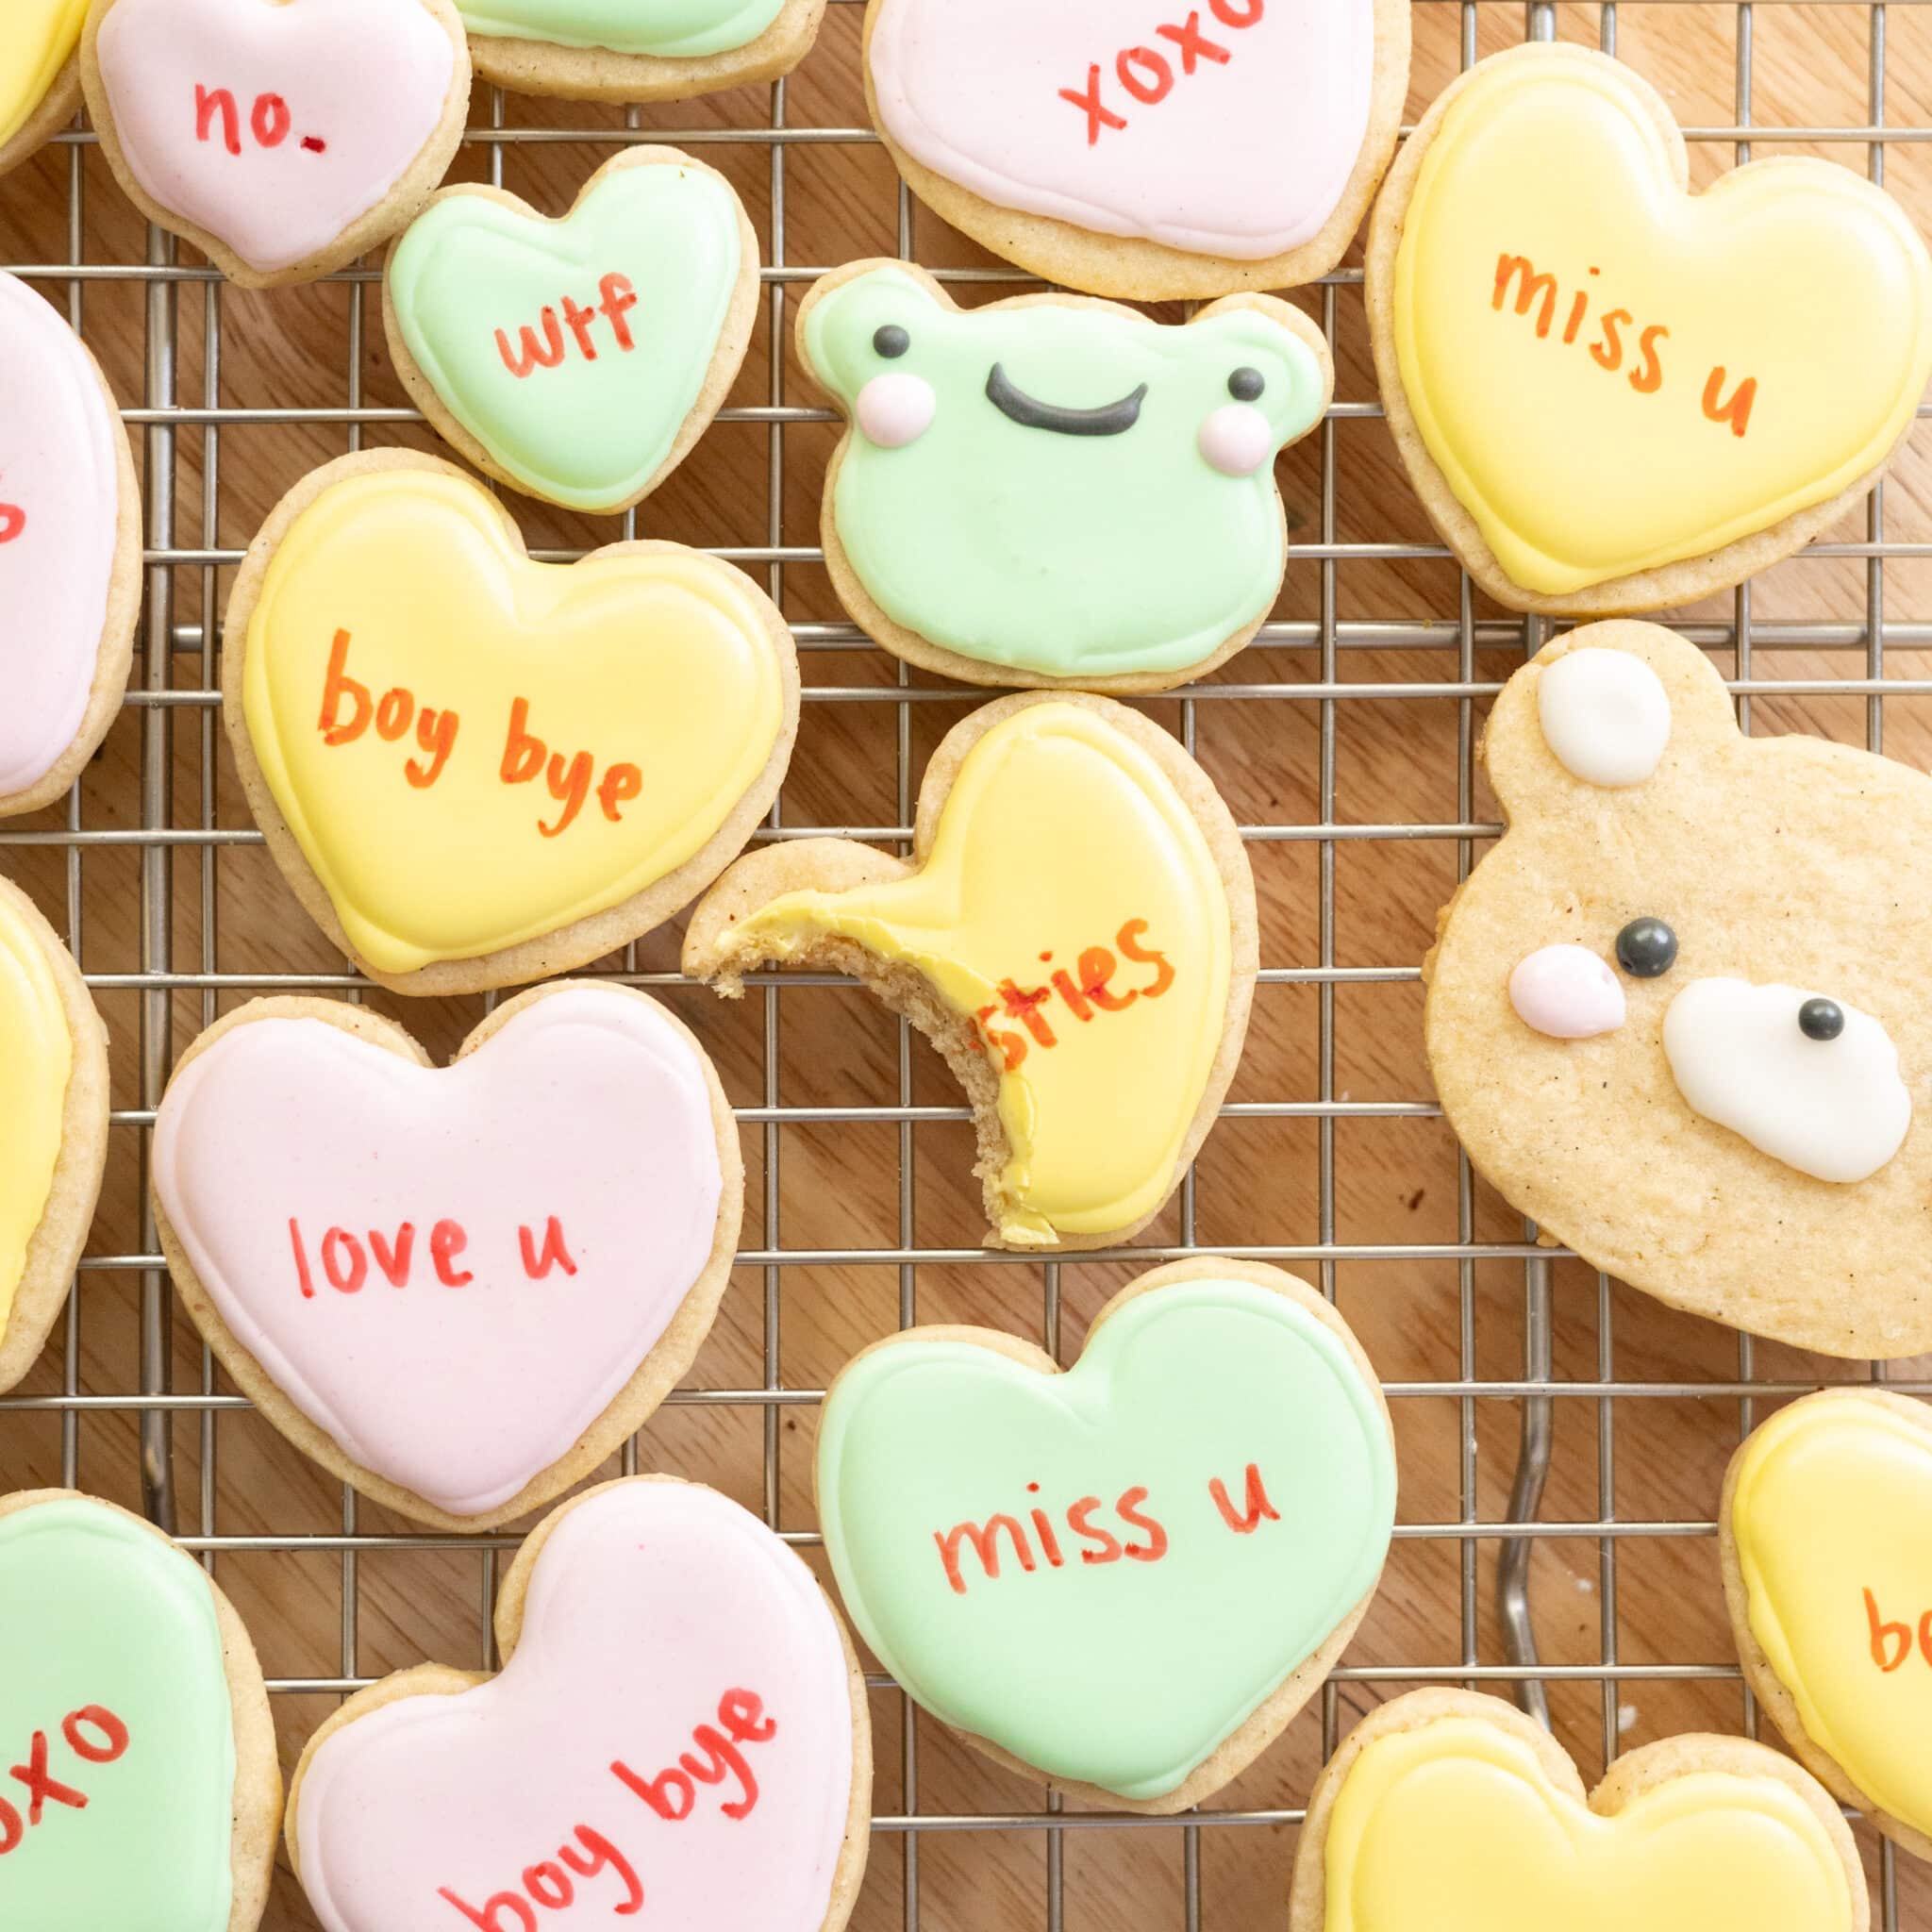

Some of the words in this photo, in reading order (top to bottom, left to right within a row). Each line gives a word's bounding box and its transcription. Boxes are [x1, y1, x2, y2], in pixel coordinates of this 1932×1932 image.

[194, 82, 327, 157] no.
[493, 271, 639, 379] wtf
[1491, 252, 1671, 394] miss
[1701, 365, 1758, 439] u
[317, 627, 460, 790] boy
[499, 695, 643, 839] bye
[288, 1217, 475, 1299] love
[518, 1214, 578, 1280] u
[932, 1486, 1169, 1594] miss
[1208, 1462, 1281, 1534] u
[436, 1824, 645, 1932] boy
[608, 1687, 777, 1822] bye
